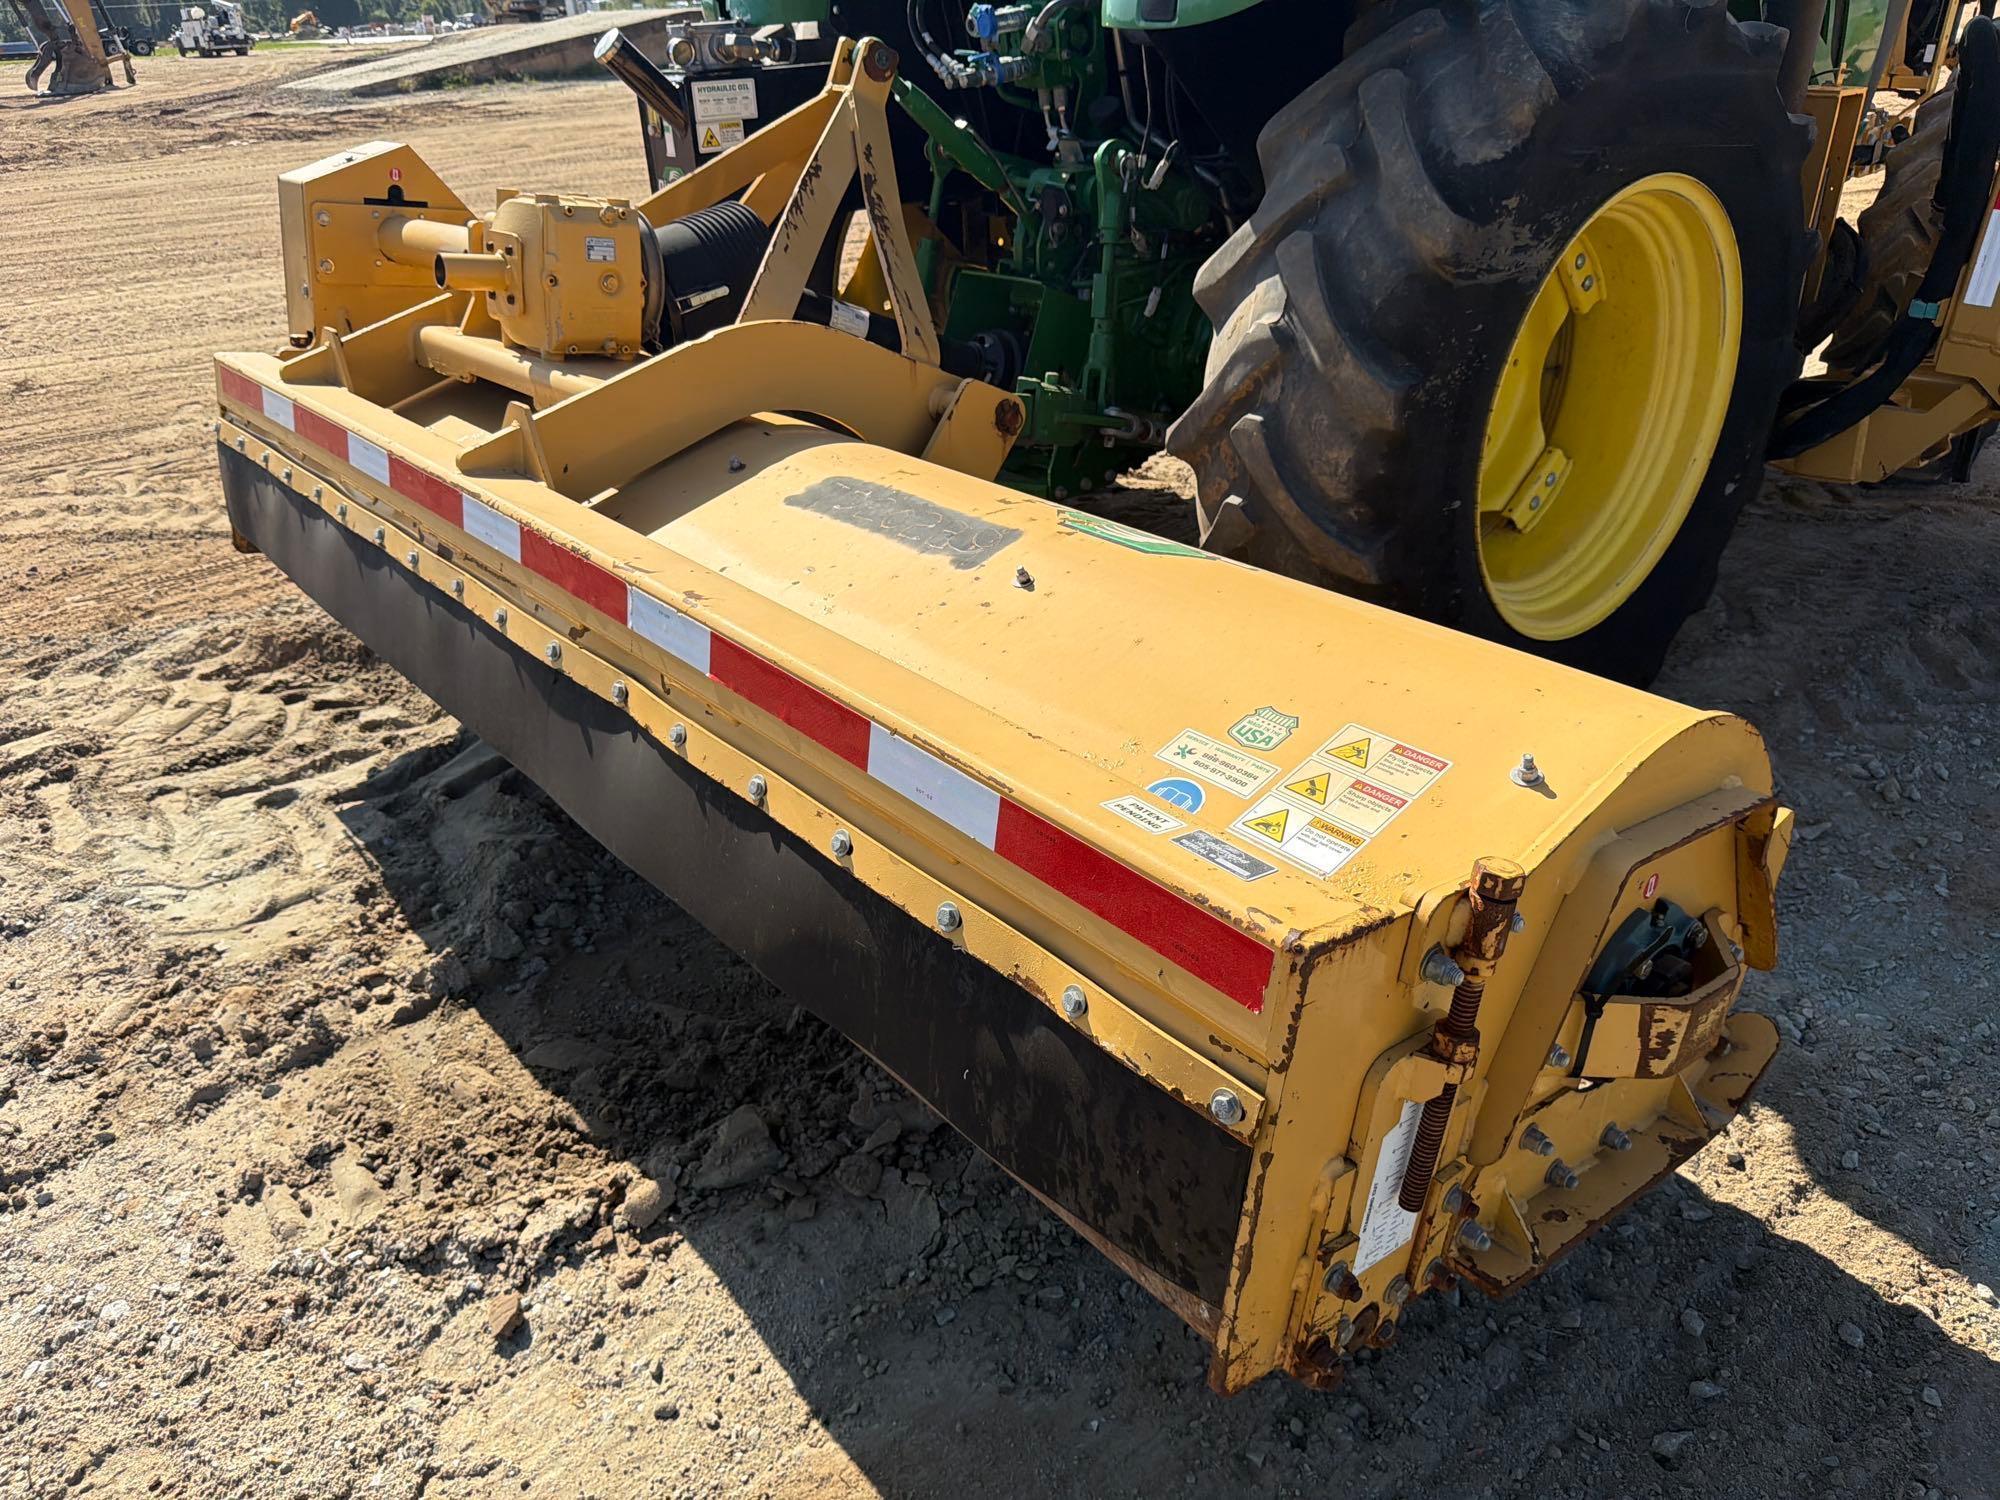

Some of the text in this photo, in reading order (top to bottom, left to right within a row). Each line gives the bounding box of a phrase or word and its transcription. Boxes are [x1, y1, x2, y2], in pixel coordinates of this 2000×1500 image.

[697, 83, 750, 94] HYDRAULIC OIL
[1236, 724, 1274, 746] USA
[1271, 729, 1282, 737] THE
[1186, 734, 1271, 774] SERVICE WARRANTY PARTS
[1387, 753, 1434, 775] Flying objects
[1403, 748, 1444, 769] DANGER
[1346, 789, 1392, 812] Sharp objects
[1355, 800, 1370, 808] hands
[1362, 785, 1403, 807] DANGER
[1113, 803, 1163, 830] PENDING
[1129, 802, 1171, 824] PATENT
[1304, 827, 1351, 852] Do not operate
[1320, 822, 1361, 845] WARNING
